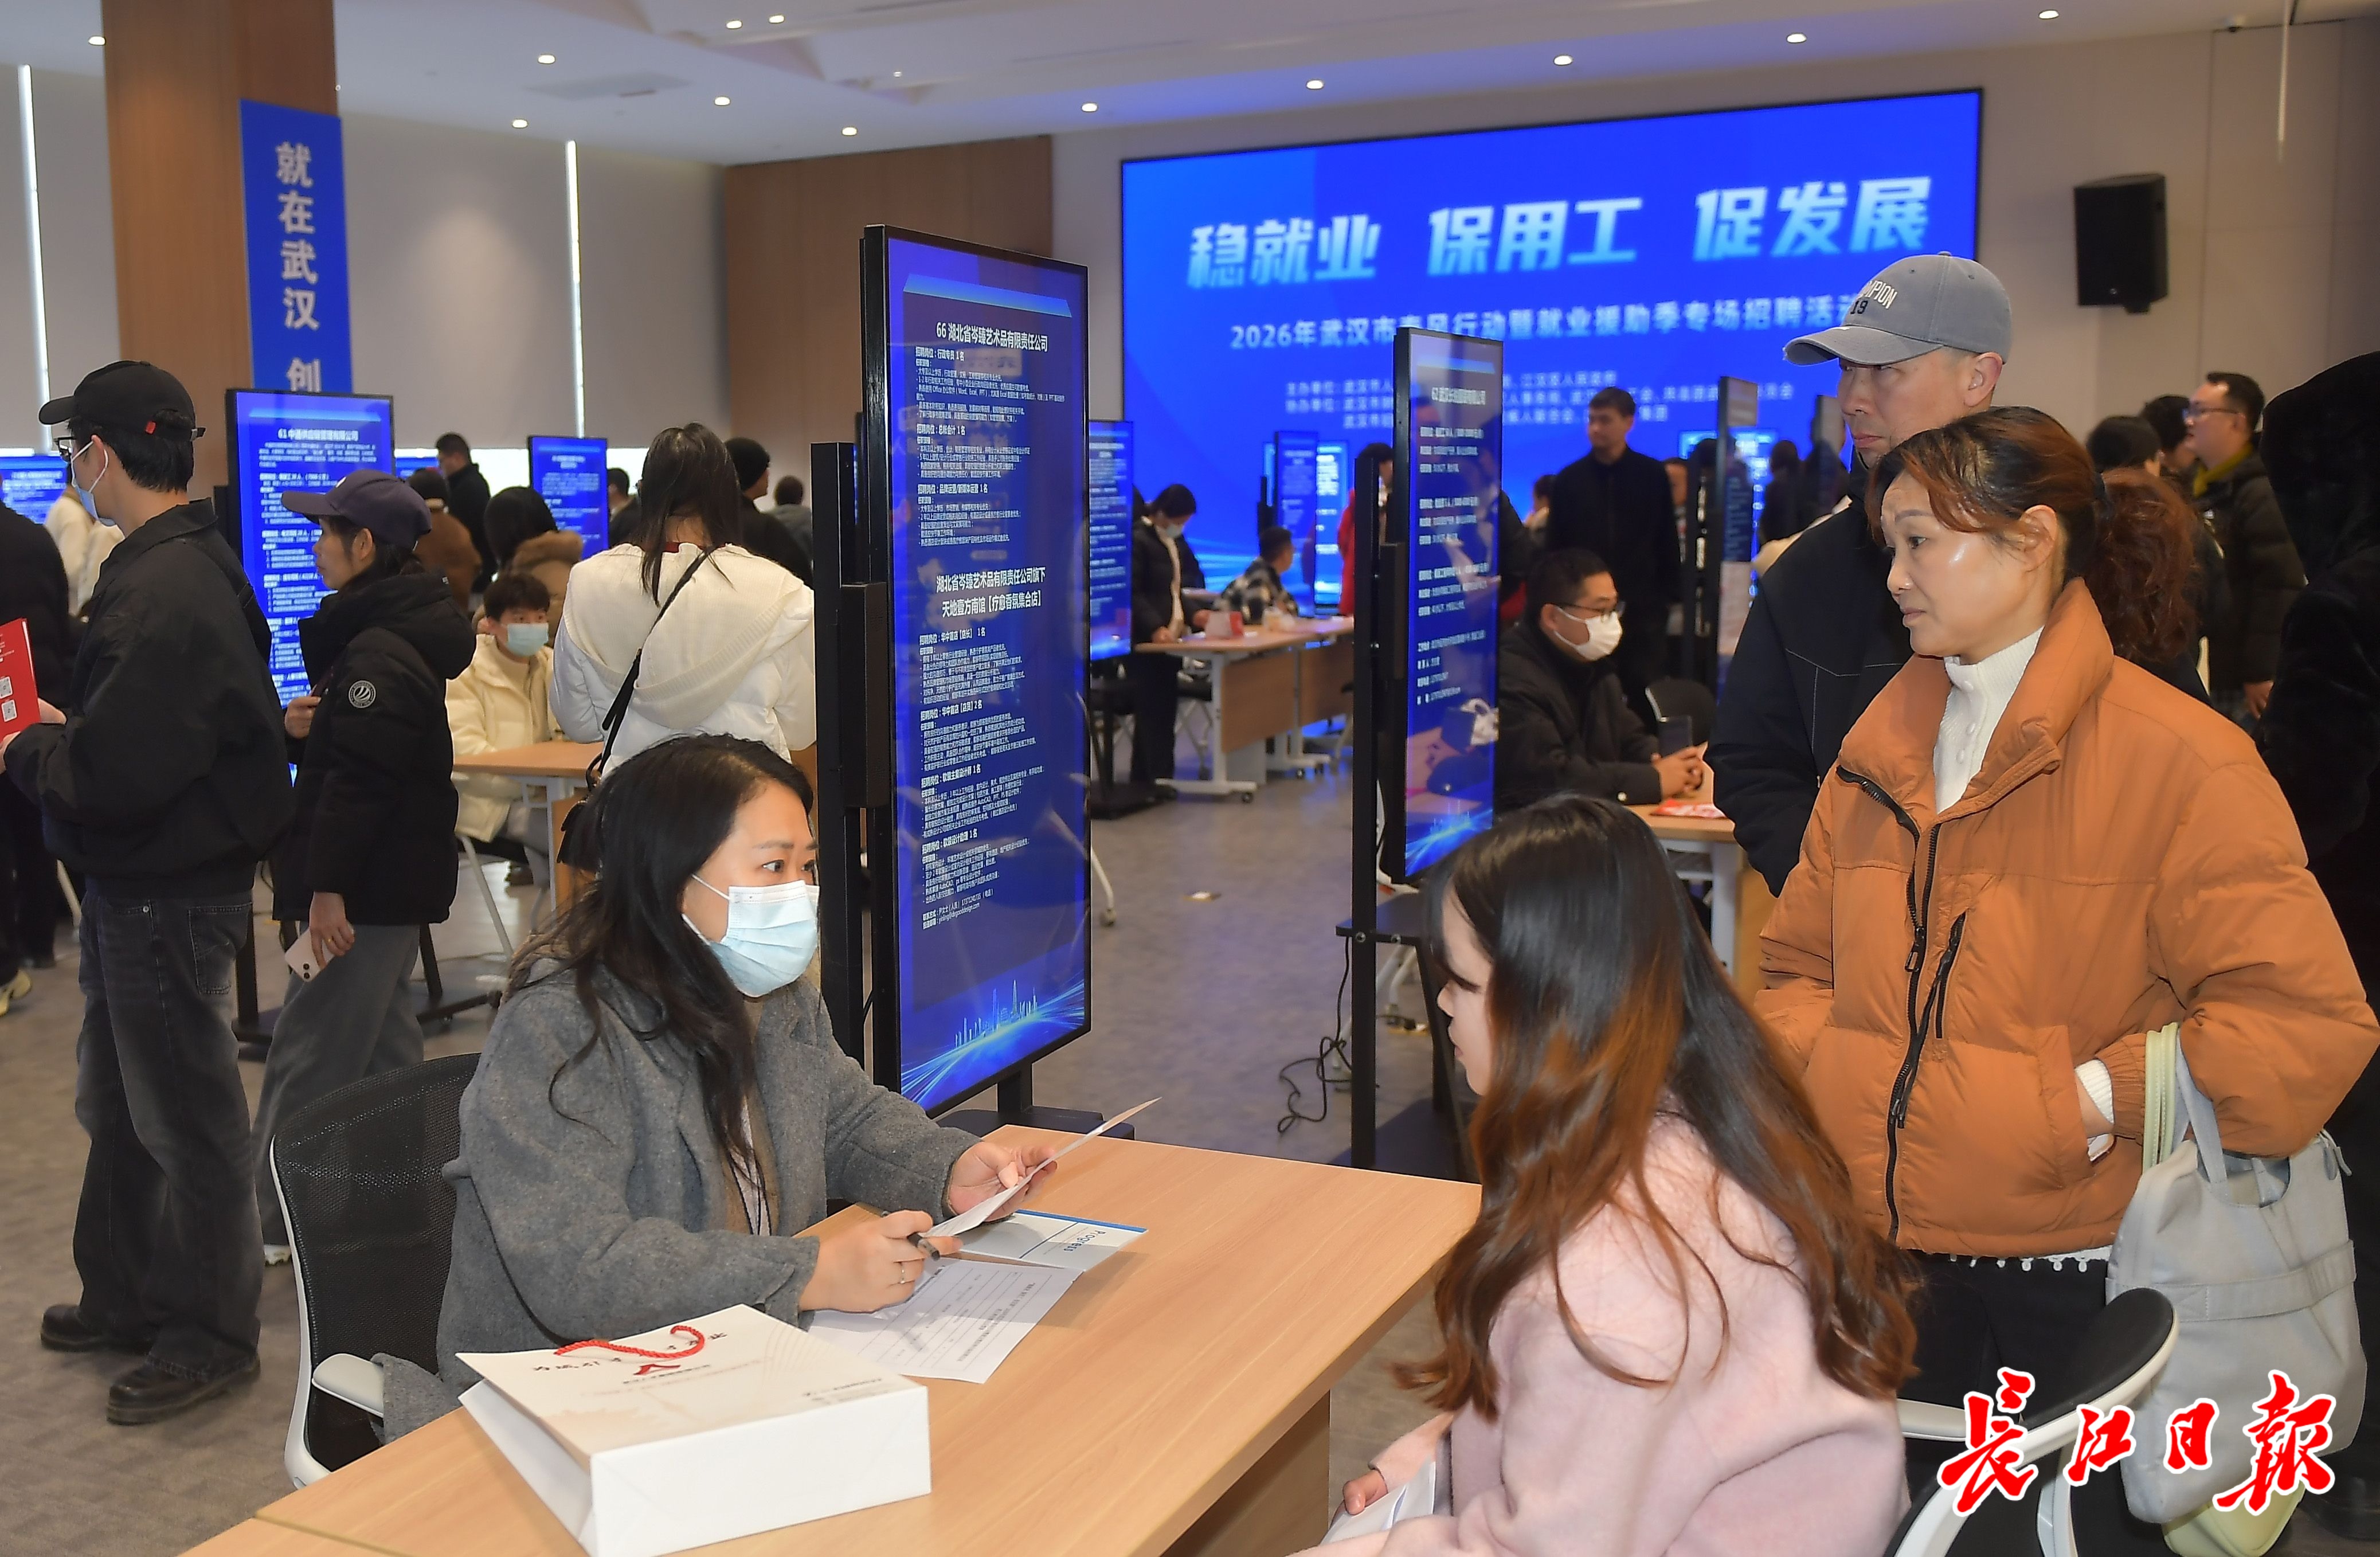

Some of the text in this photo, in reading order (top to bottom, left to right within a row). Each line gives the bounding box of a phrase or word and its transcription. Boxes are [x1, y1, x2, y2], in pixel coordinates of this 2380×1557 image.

[276, 142, 319, 331] 就在武汉
[1186, 176, 1931, 288] 稳就业 保用工 促发展
[936, 322, 1047, 352] 66 湖北省岑臻艺术品有限责任公司
[936, 566, 1045, 592] 湖北省岑臻艺术品有限责任公司旗下
[1063, 1230, 1106, 1251] Progress
